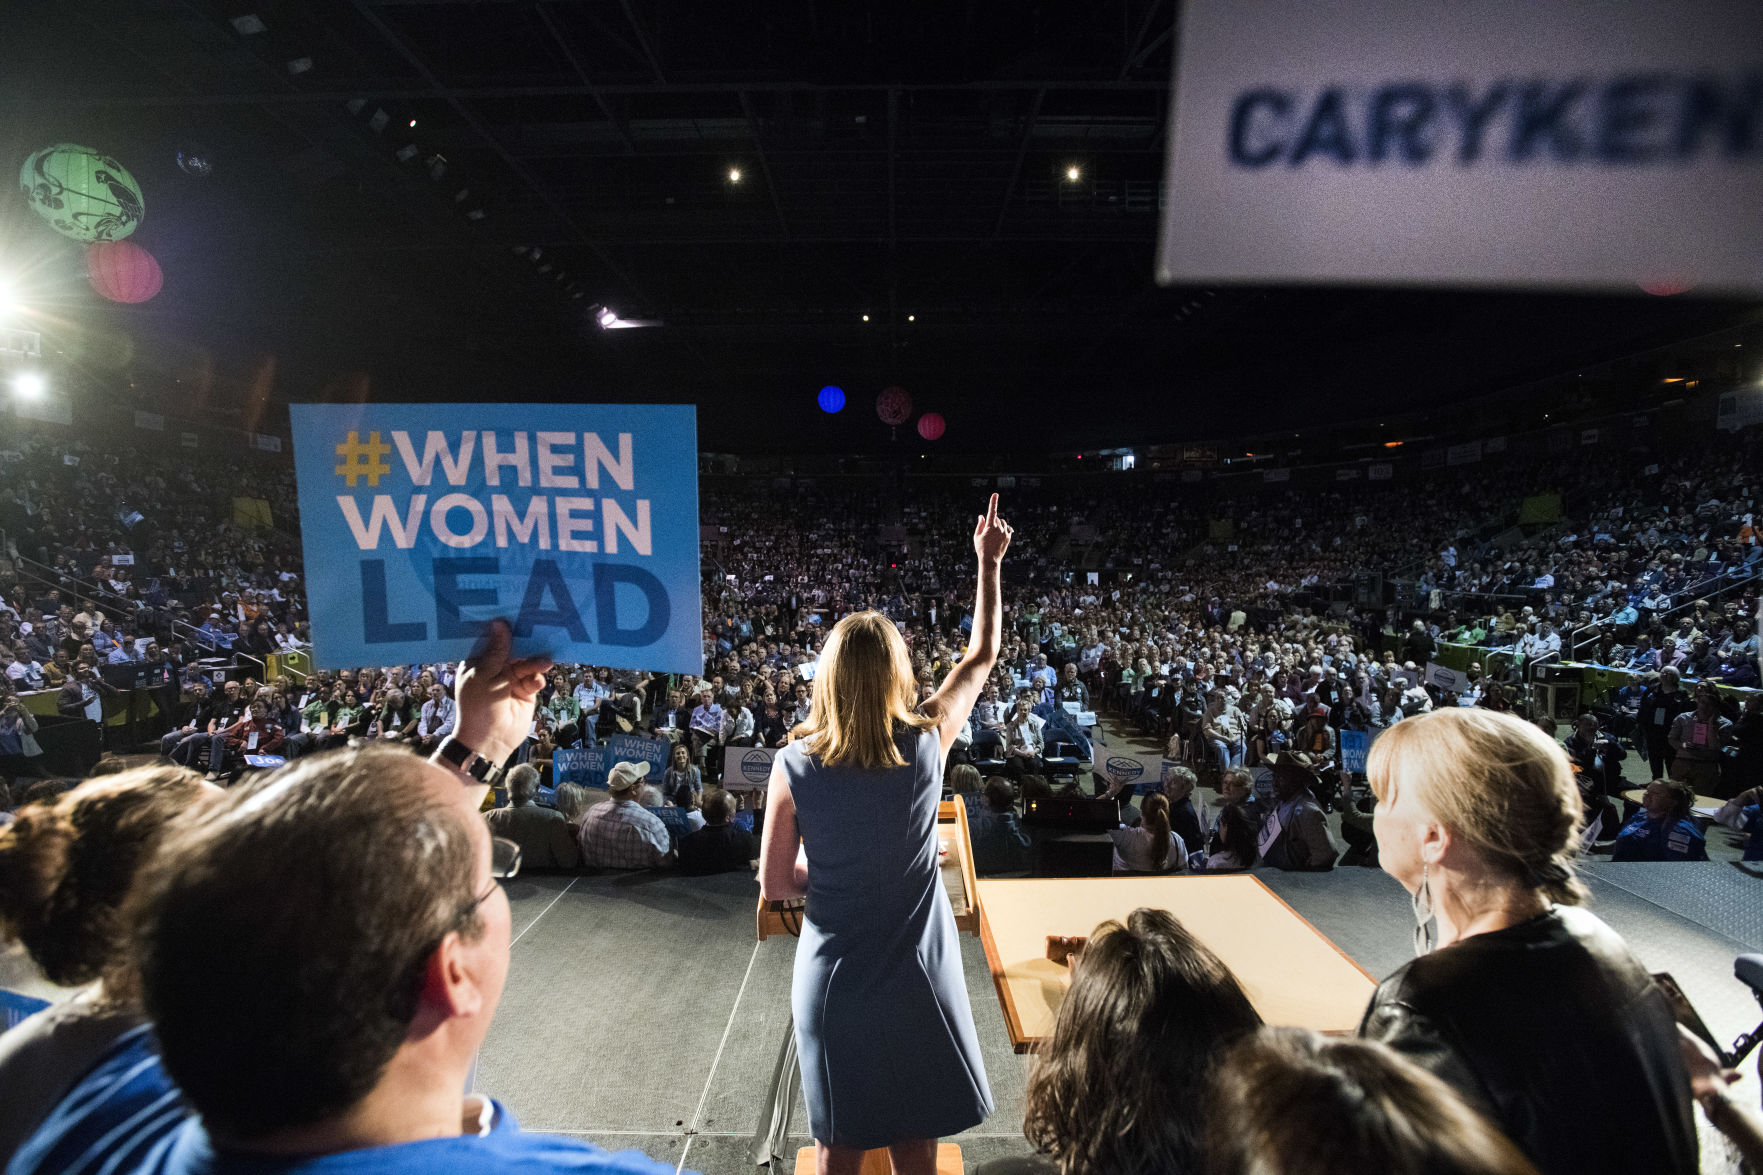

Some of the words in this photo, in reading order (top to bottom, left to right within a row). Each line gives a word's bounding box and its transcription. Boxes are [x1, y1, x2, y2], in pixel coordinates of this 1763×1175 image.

[334, 430, 634, 490] #WHEN
[336, 493, 652, 556] WOMEN
[360, 557, 671, 647] LEAD
[558, 761, 605, 772] WOMEN
[614, 747, 661, 762] WOMEN
